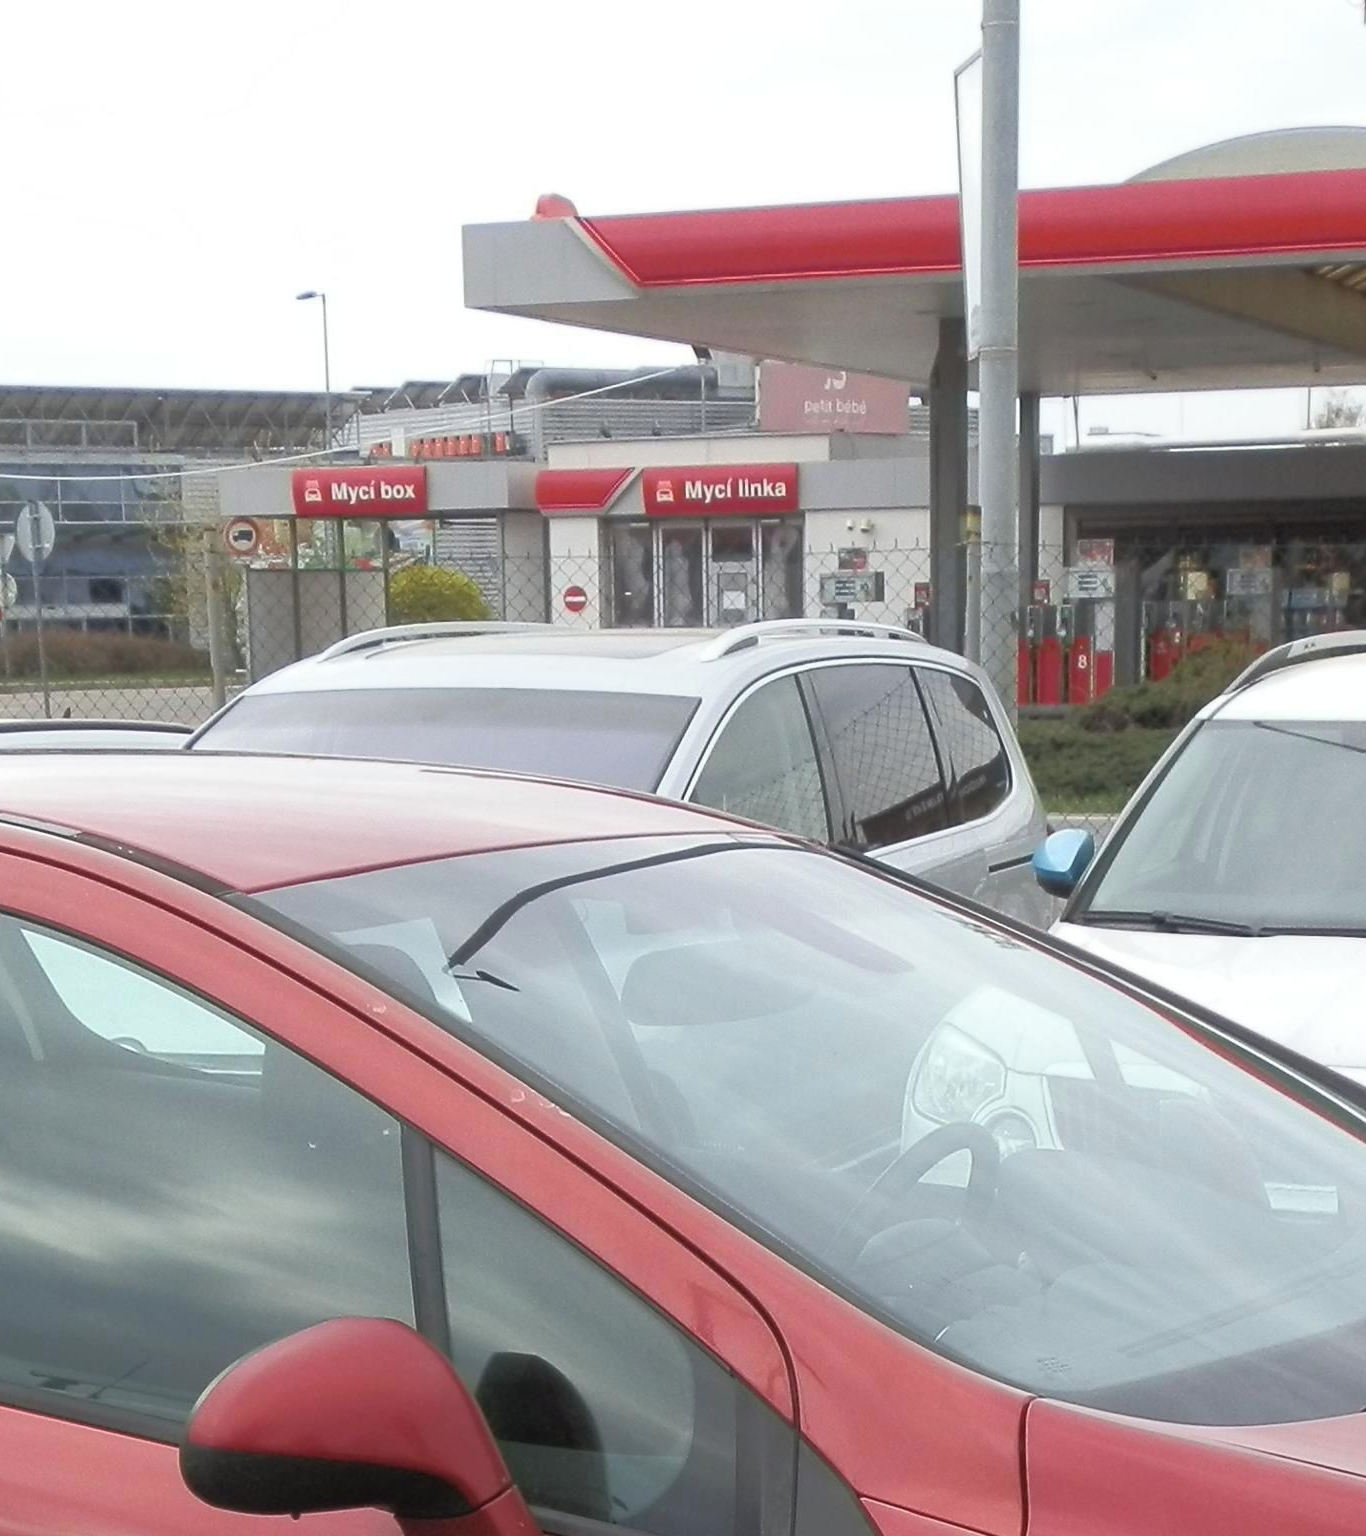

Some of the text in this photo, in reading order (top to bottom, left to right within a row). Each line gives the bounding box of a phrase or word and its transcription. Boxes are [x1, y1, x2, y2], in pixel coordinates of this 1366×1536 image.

[331, 480, 415, 504] Mycí box
[685, 478, 786, 503] Mycí linka
[1077, 654, 1088, 670] 8
